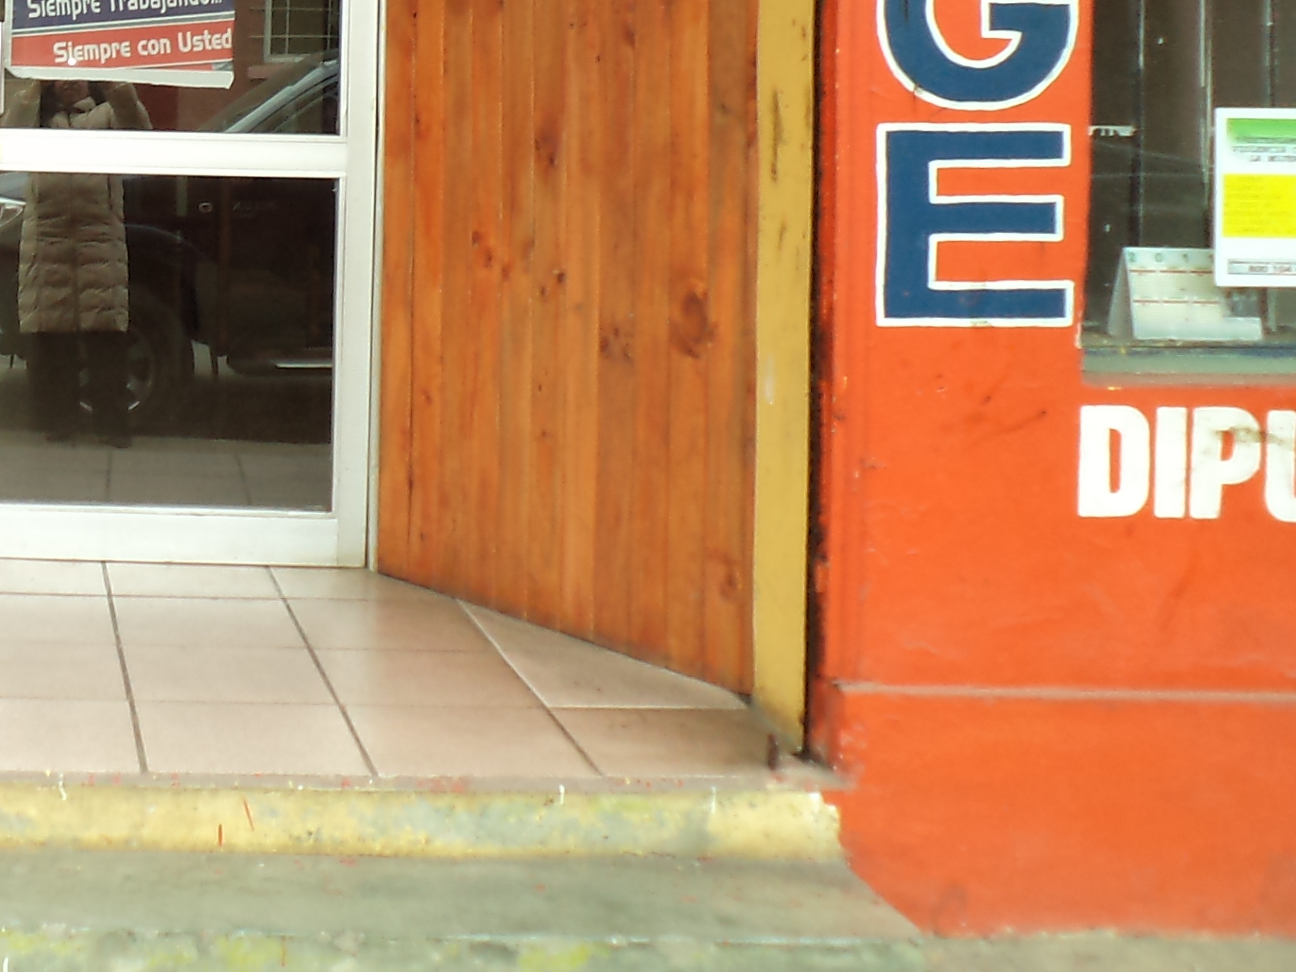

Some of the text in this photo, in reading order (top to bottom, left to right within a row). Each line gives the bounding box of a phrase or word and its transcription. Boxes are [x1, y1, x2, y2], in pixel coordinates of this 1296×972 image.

[52, 28, 233, 64] Siempre con Usted
